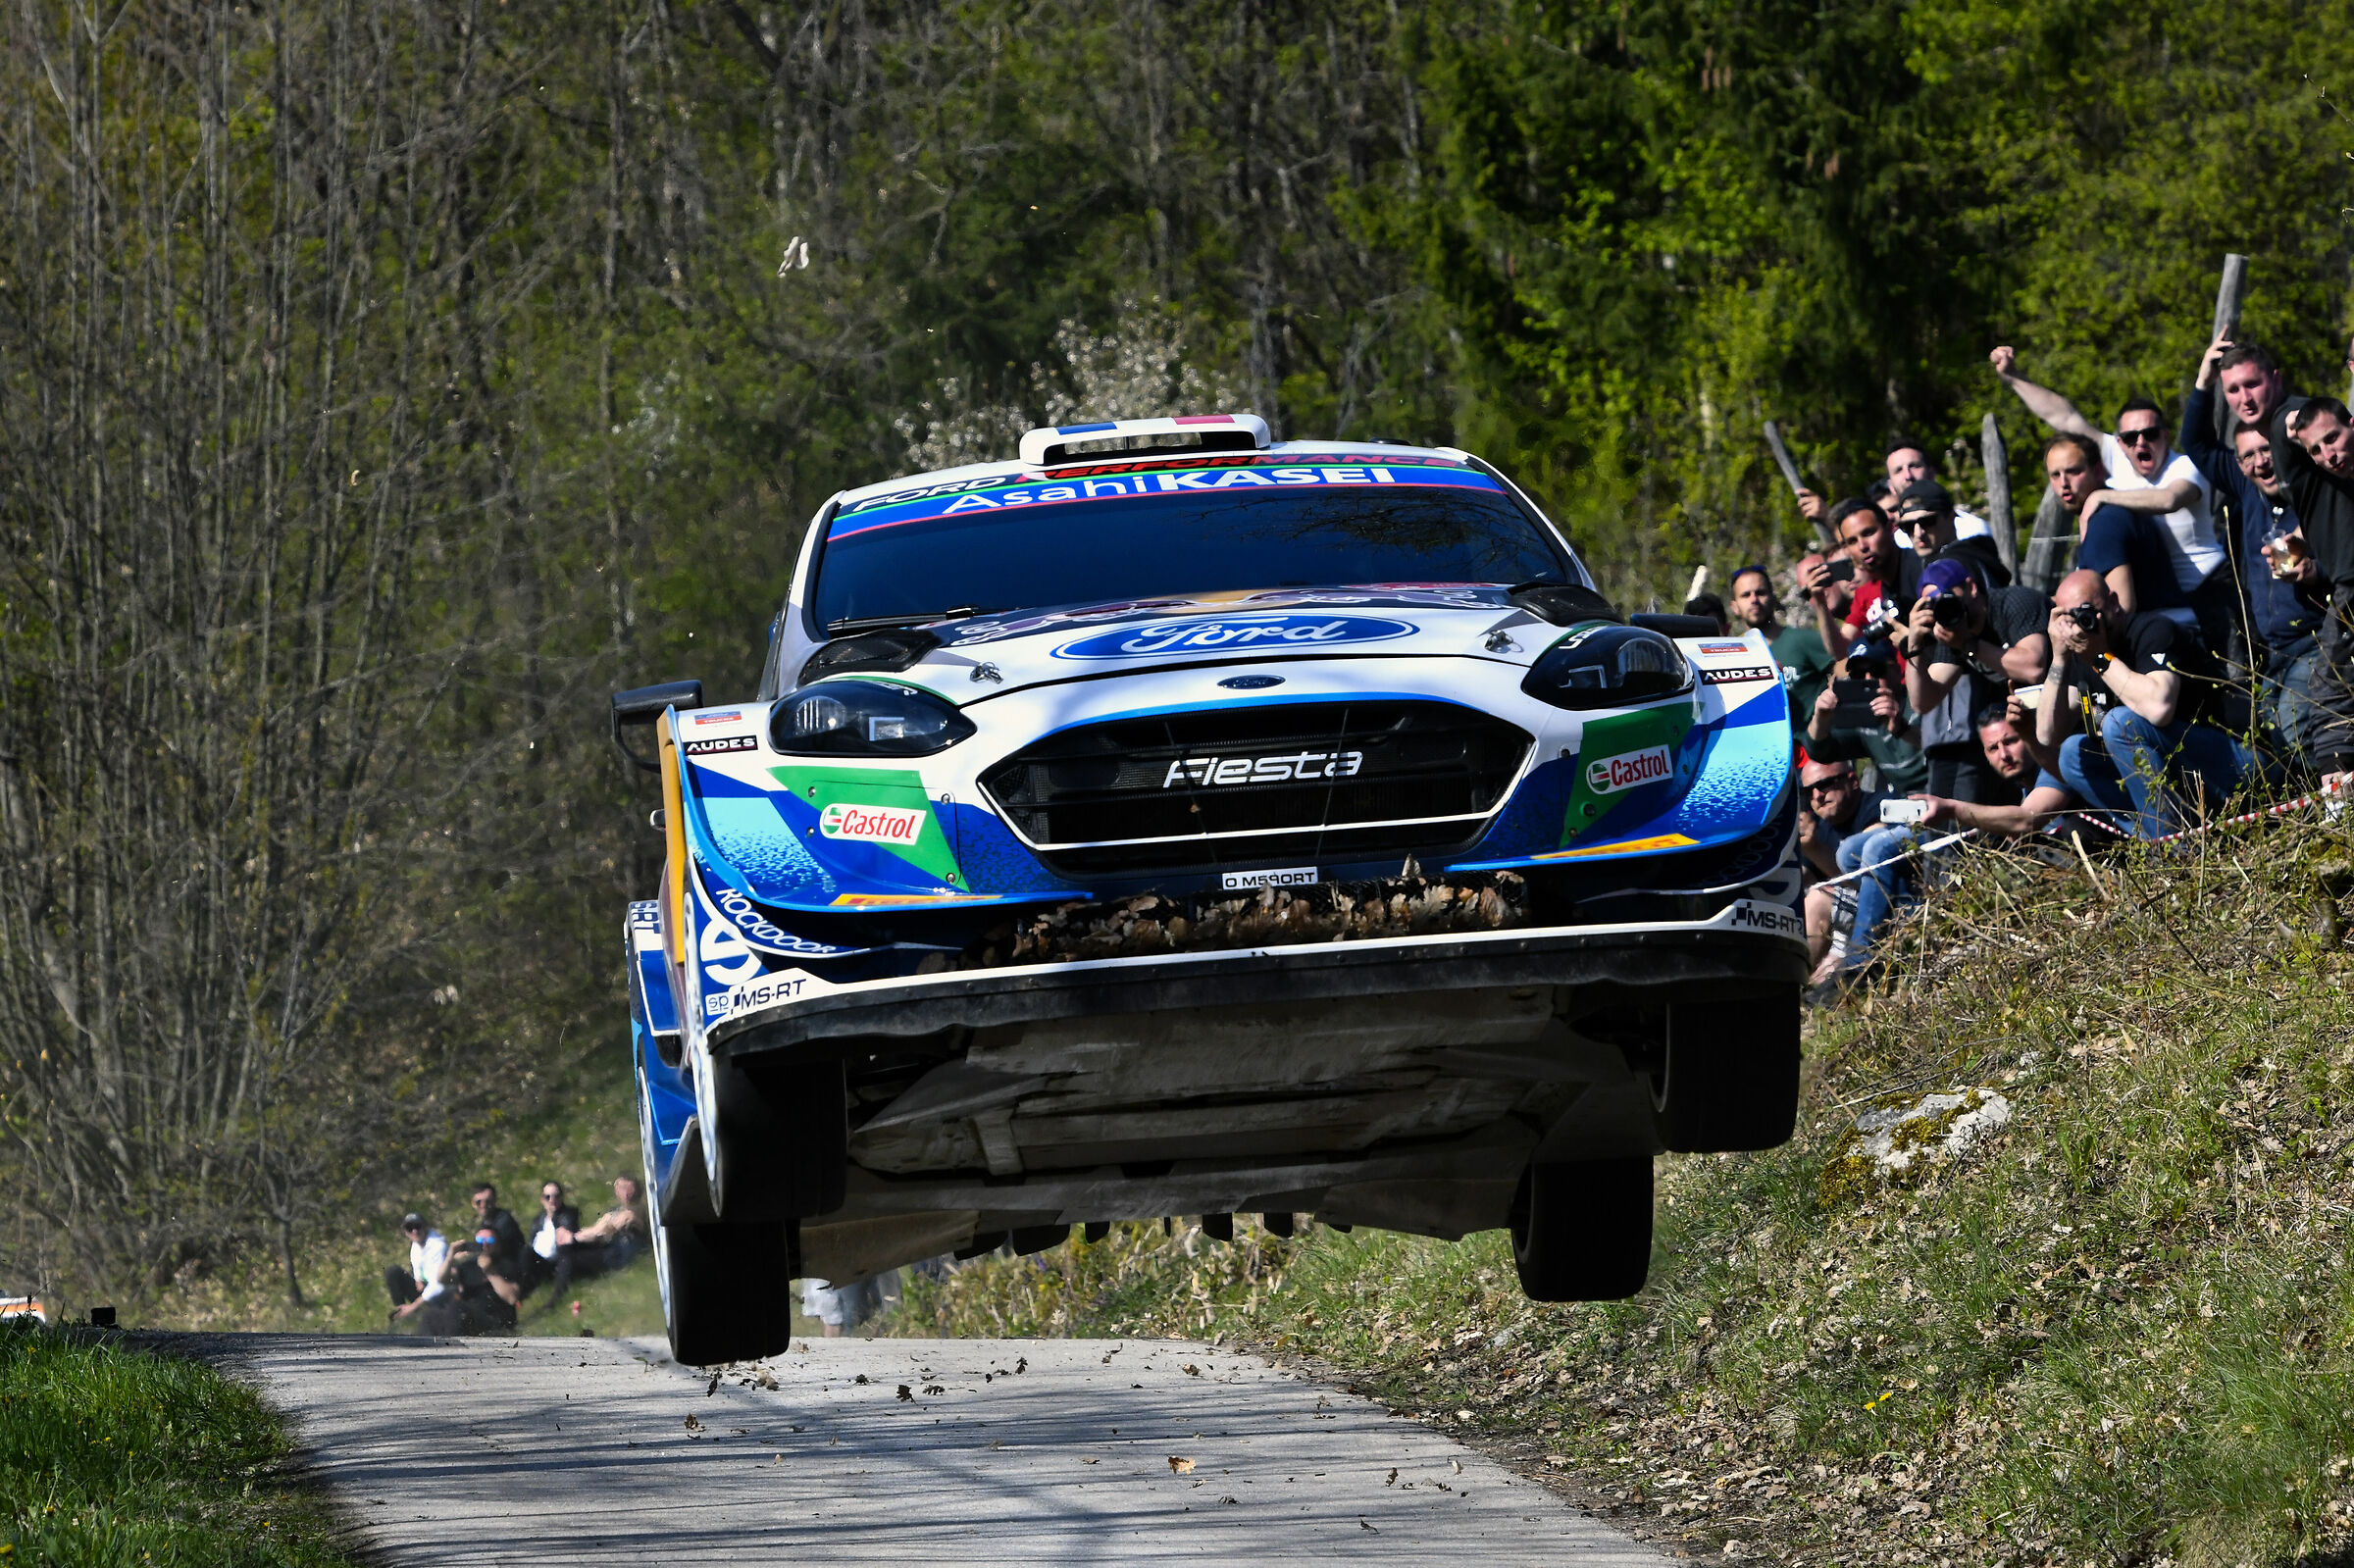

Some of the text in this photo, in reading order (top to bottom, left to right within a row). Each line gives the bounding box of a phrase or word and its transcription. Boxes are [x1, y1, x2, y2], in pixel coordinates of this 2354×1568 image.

[852, 477, 1005, 512] FORD
[1121, 617, 1349, 652] Ford
[1704, 668, 1770, 681] AUDES
[687, 737, 755, 752] AUDES
[1162, 751, 1363, 787] Fiesta
[1611, 749, 1669, 786] Castrol
[843, 809, 915, 839] Castrol
[716, 887, 837, 953] ROCKDOOR
